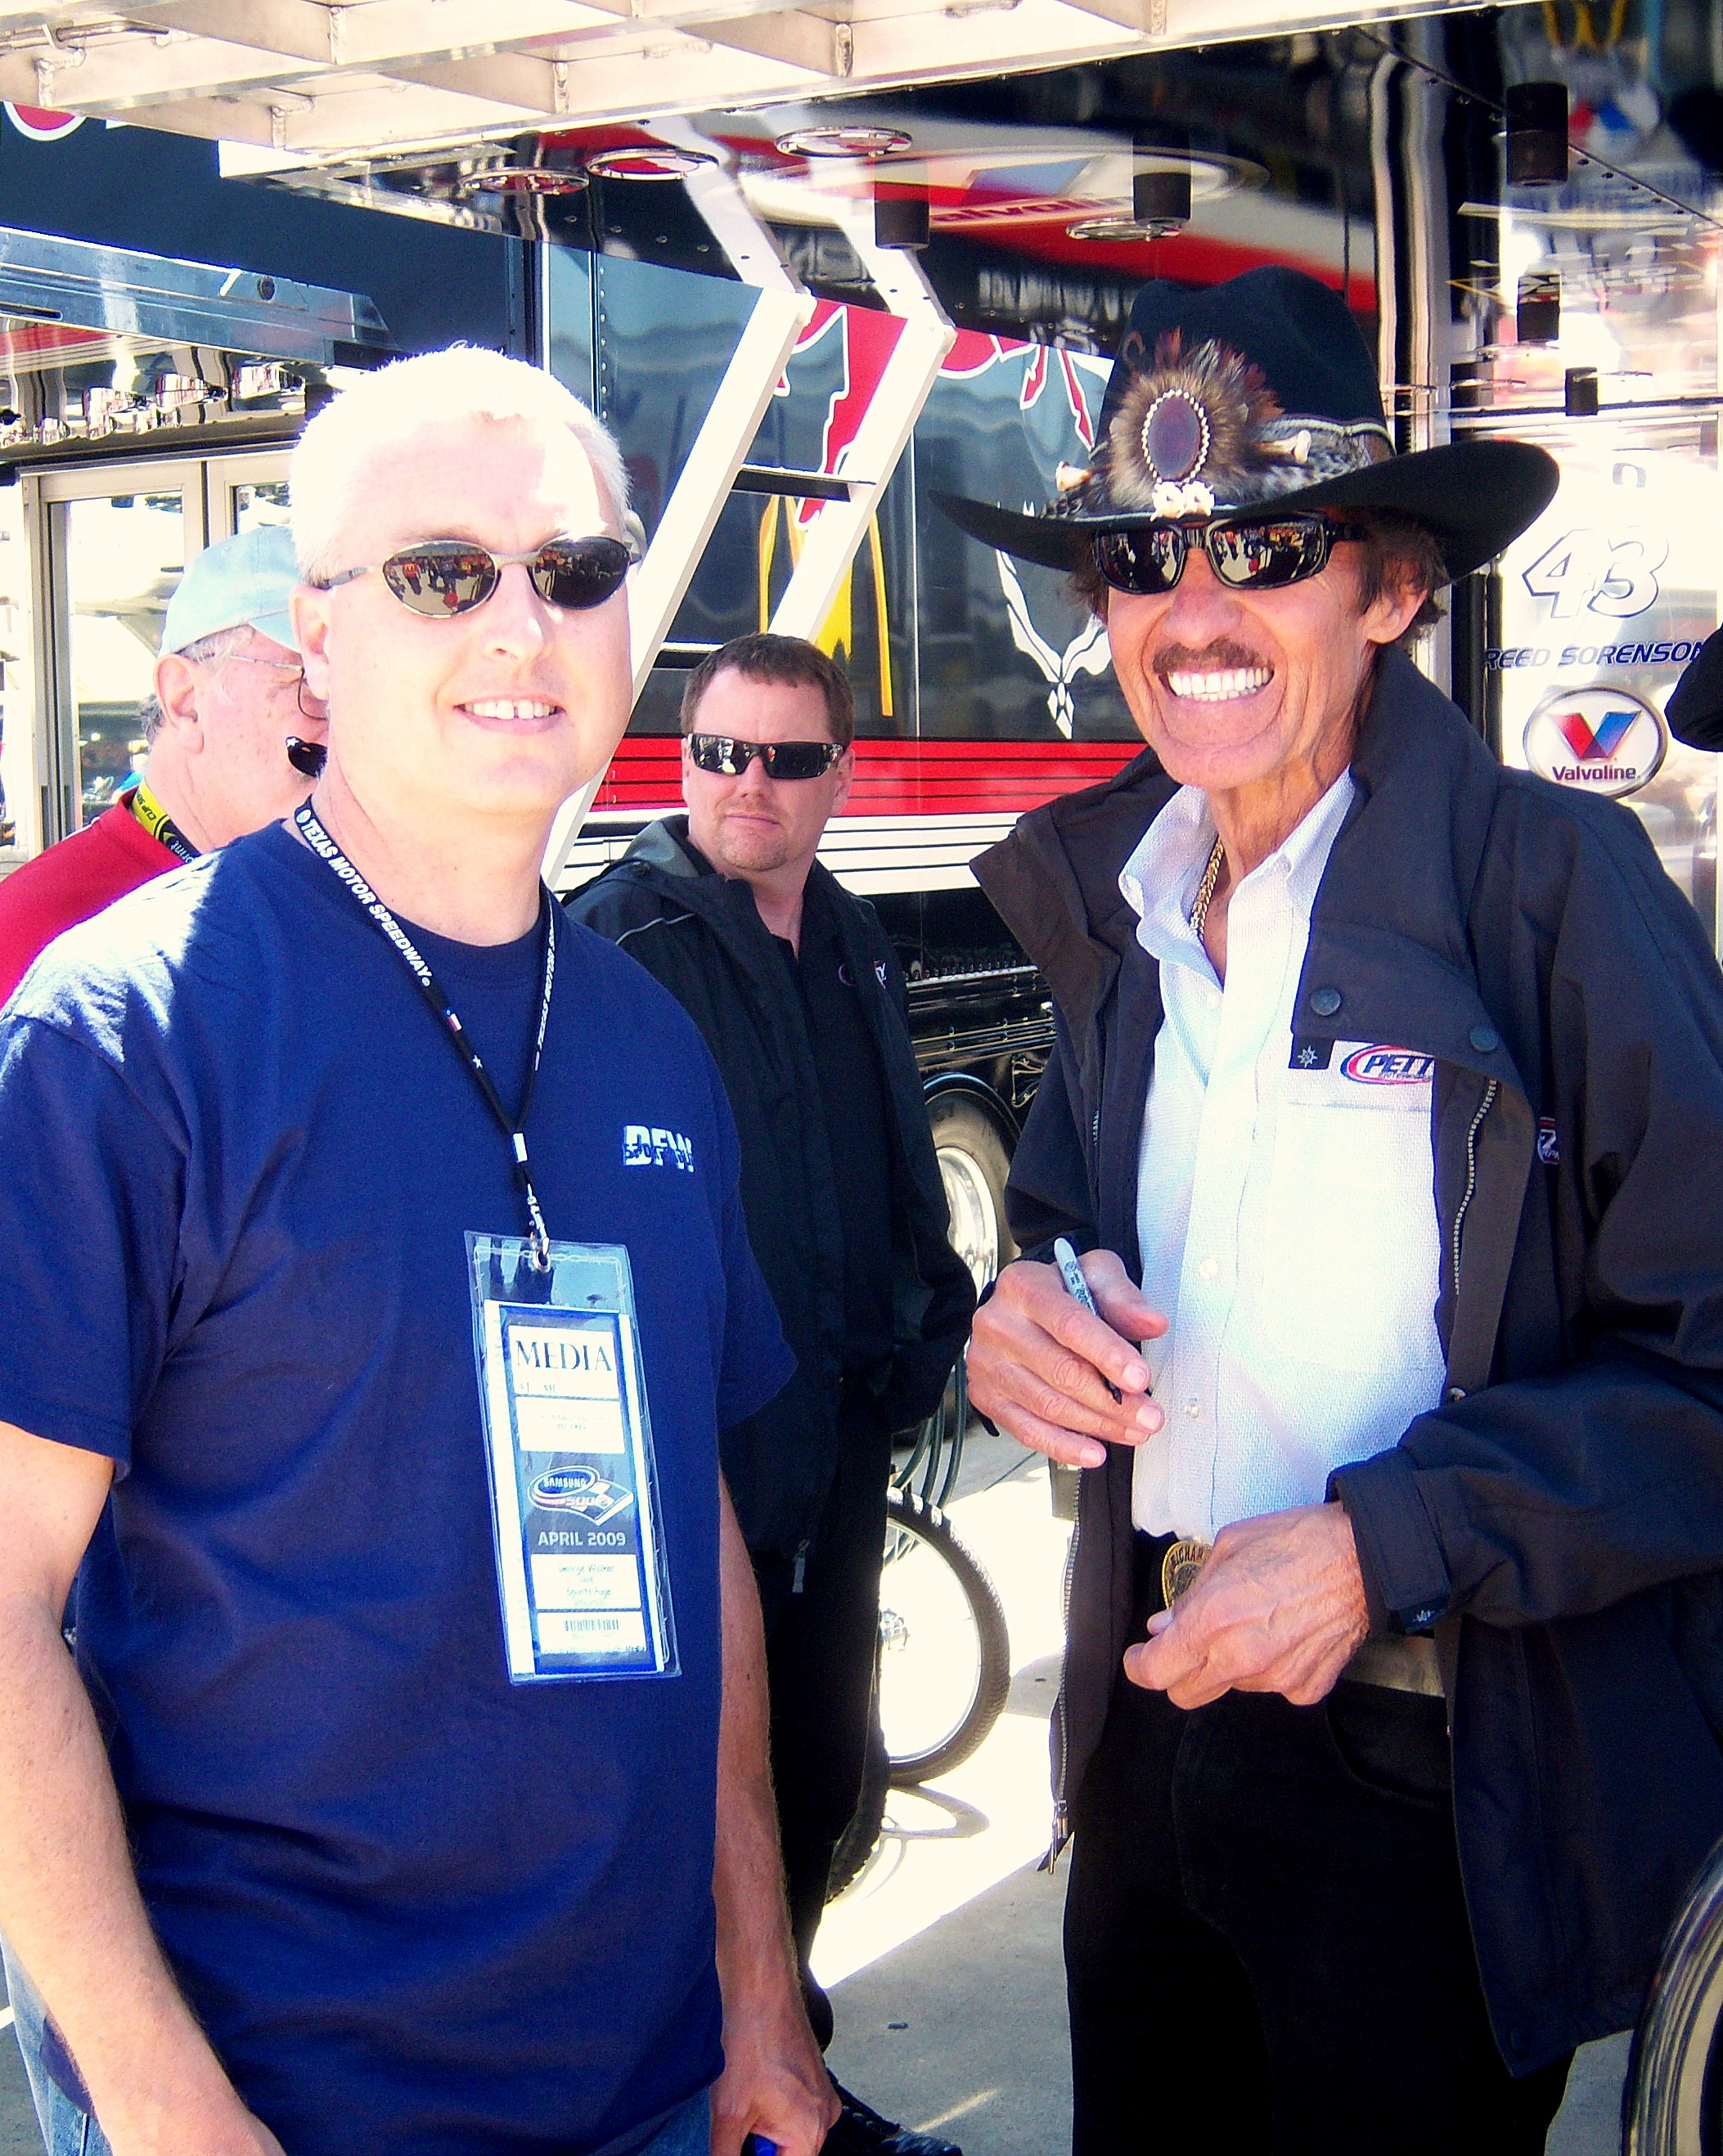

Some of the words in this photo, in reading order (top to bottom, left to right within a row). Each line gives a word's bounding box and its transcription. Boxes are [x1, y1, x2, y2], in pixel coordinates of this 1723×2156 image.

[1522, 526, 1670, 620] 43
[1482, 647, 1550, 669] REED
[1551, 765, 1636, 781] Valvoline
[301, 820, 338, 858] TEXAS
[327, 856, 376, 905] MOTOR
[369, 903, 432, 977] SPEEDWAY
[1362, 1053, 1434, 1075] PETT
[515, 1340, 612, 1372] MEDIA
[543, 1477, 587, 1488] SAMSUNG
[538, 1531, 583, 1546] APRIL
[587, 1532, 627, 1546] 2009
